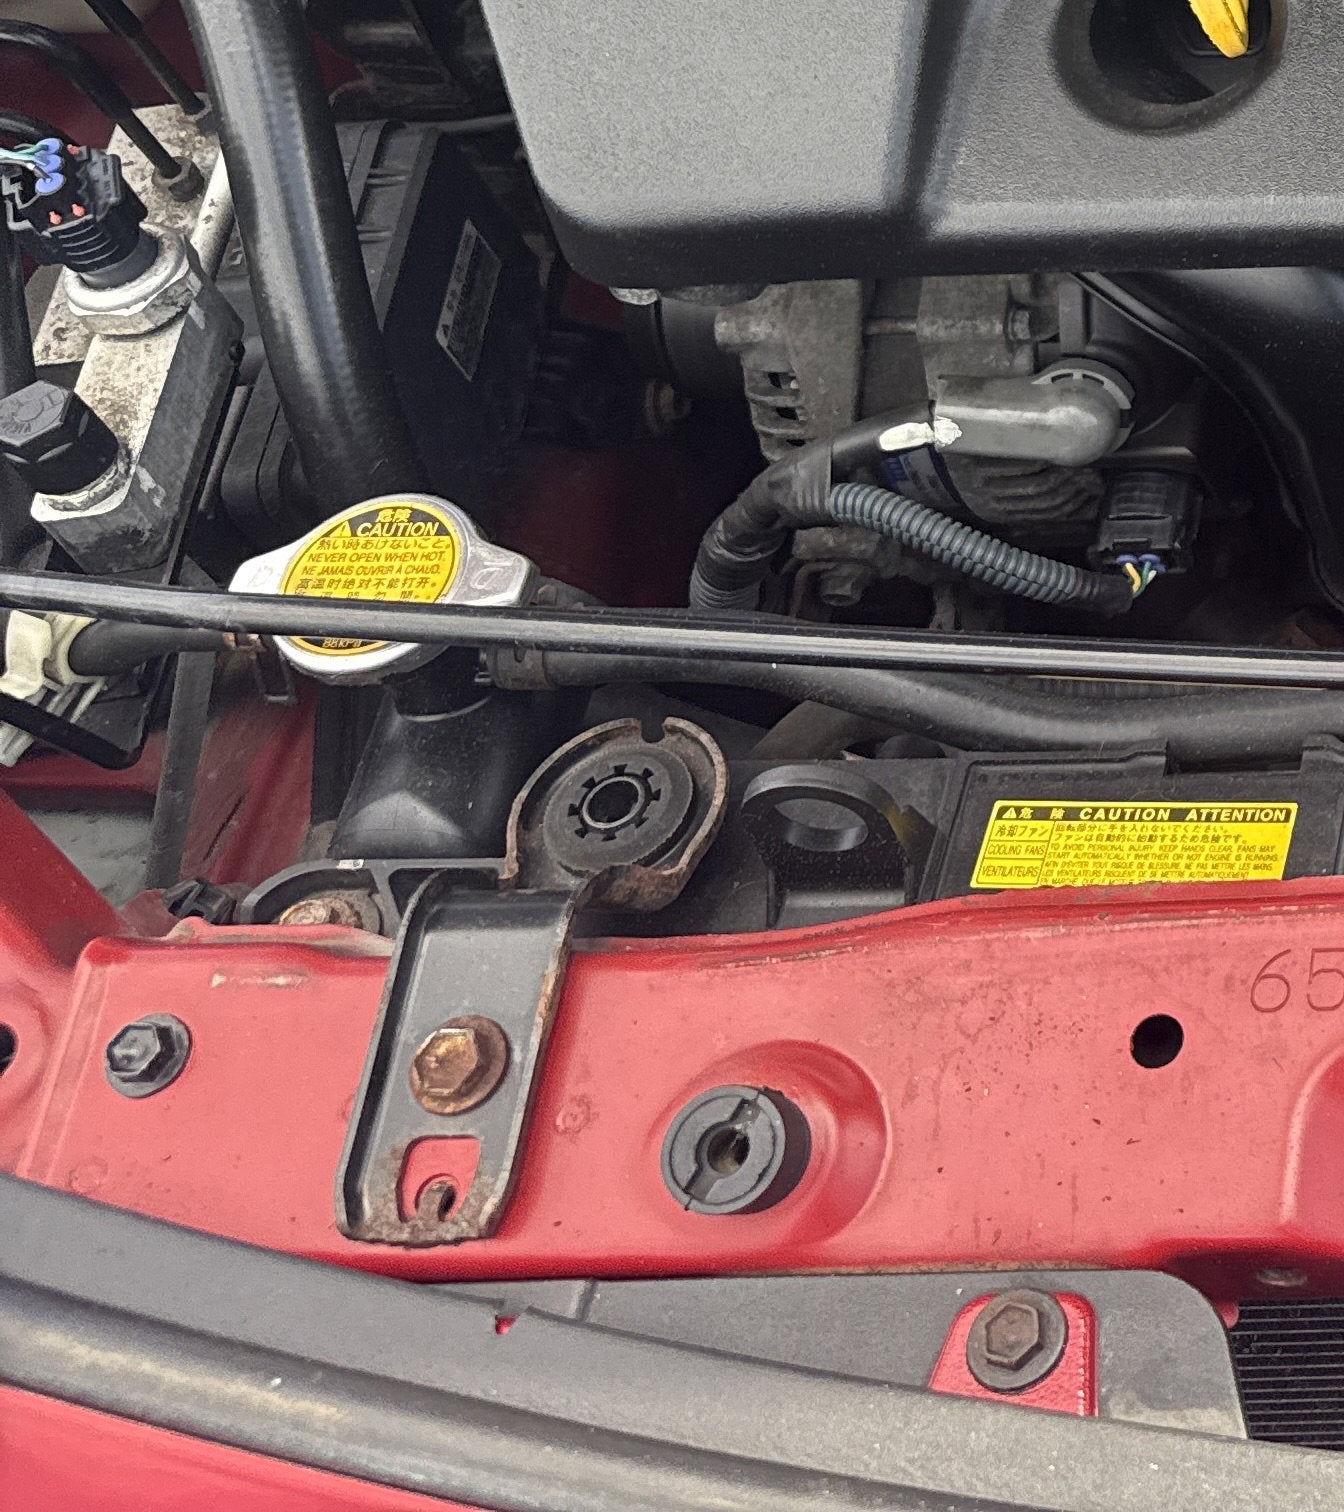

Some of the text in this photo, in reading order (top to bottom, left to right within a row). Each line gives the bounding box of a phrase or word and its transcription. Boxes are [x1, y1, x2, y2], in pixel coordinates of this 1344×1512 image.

[356, 521, 439, 537] CAUTION
[307, 551, 446, 563] NEVER OPEN WHEN HOT.
[301, 566, 318, 576] NE
[318, 566, 353, 576] JAMAIS
[356, 565, 394, 575] OUVRIR
[404, 565, 441, 574] CHAUD.
[1079, 808, 1170, 821] CAUTION
[1184, 808, 1287, 822] ATTENTION
[995, 825, 1049, 837] 冷却ファン
[988, 845, 1045, 856] COOLING FANS
[982, 866, 1039, 878] VENTILATEURS
